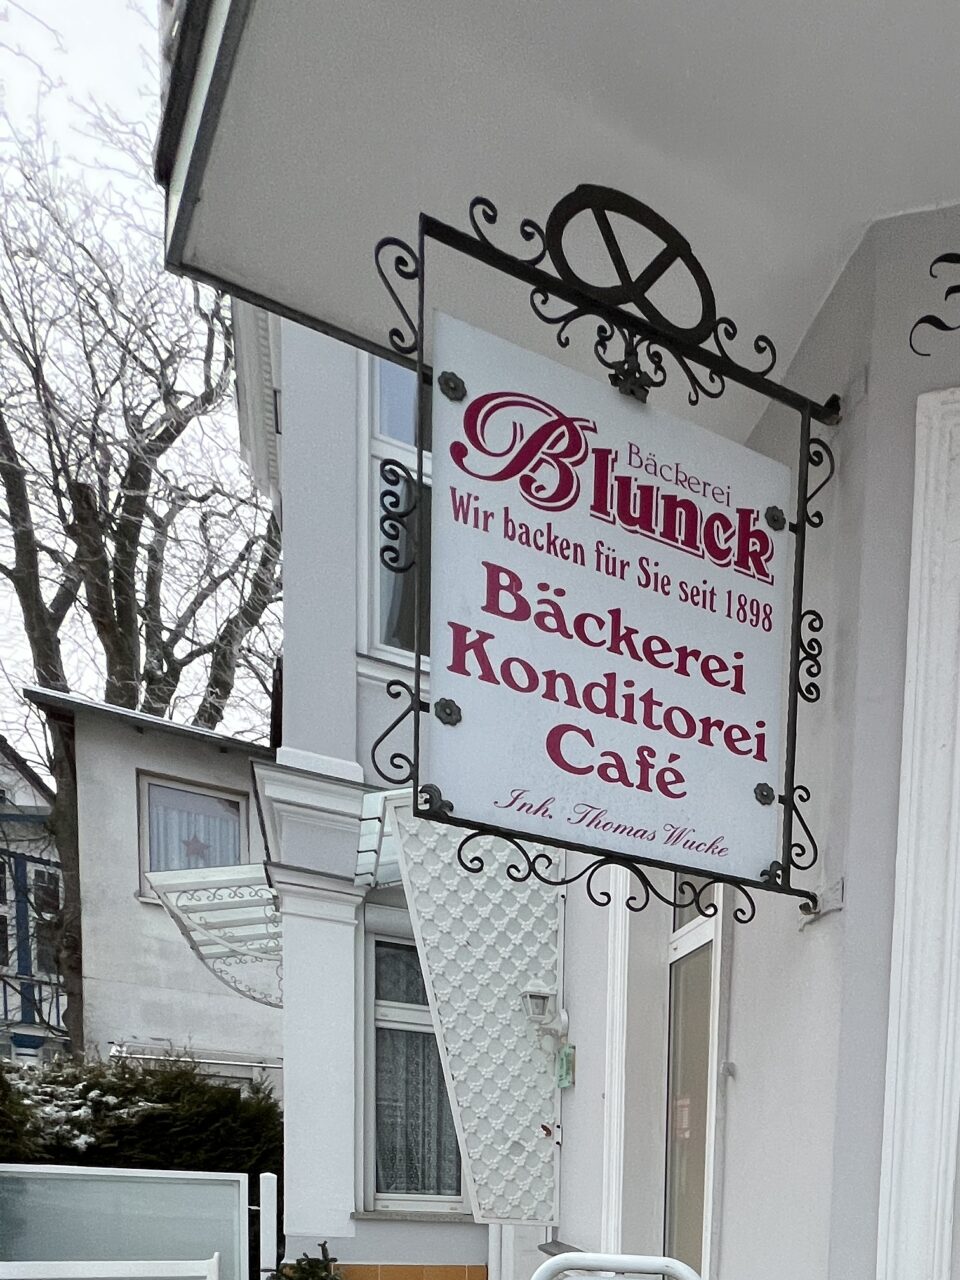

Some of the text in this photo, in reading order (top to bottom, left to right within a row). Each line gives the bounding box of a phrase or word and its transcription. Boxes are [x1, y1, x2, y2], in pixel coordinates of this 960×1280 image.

[449, 391, 775, 586] Blunck
[627, 440, 732, 508] Bäckerei
[450, 486, 774, 633] Wir backen für Sie seit 1898
[447, 621, 768, 763] Konditorei
[481, 560, 746, 695] Bäckerei
[493, 788, 729, 858] Inh. Thomas Wucke
[546, 723, 688, 800] Café
